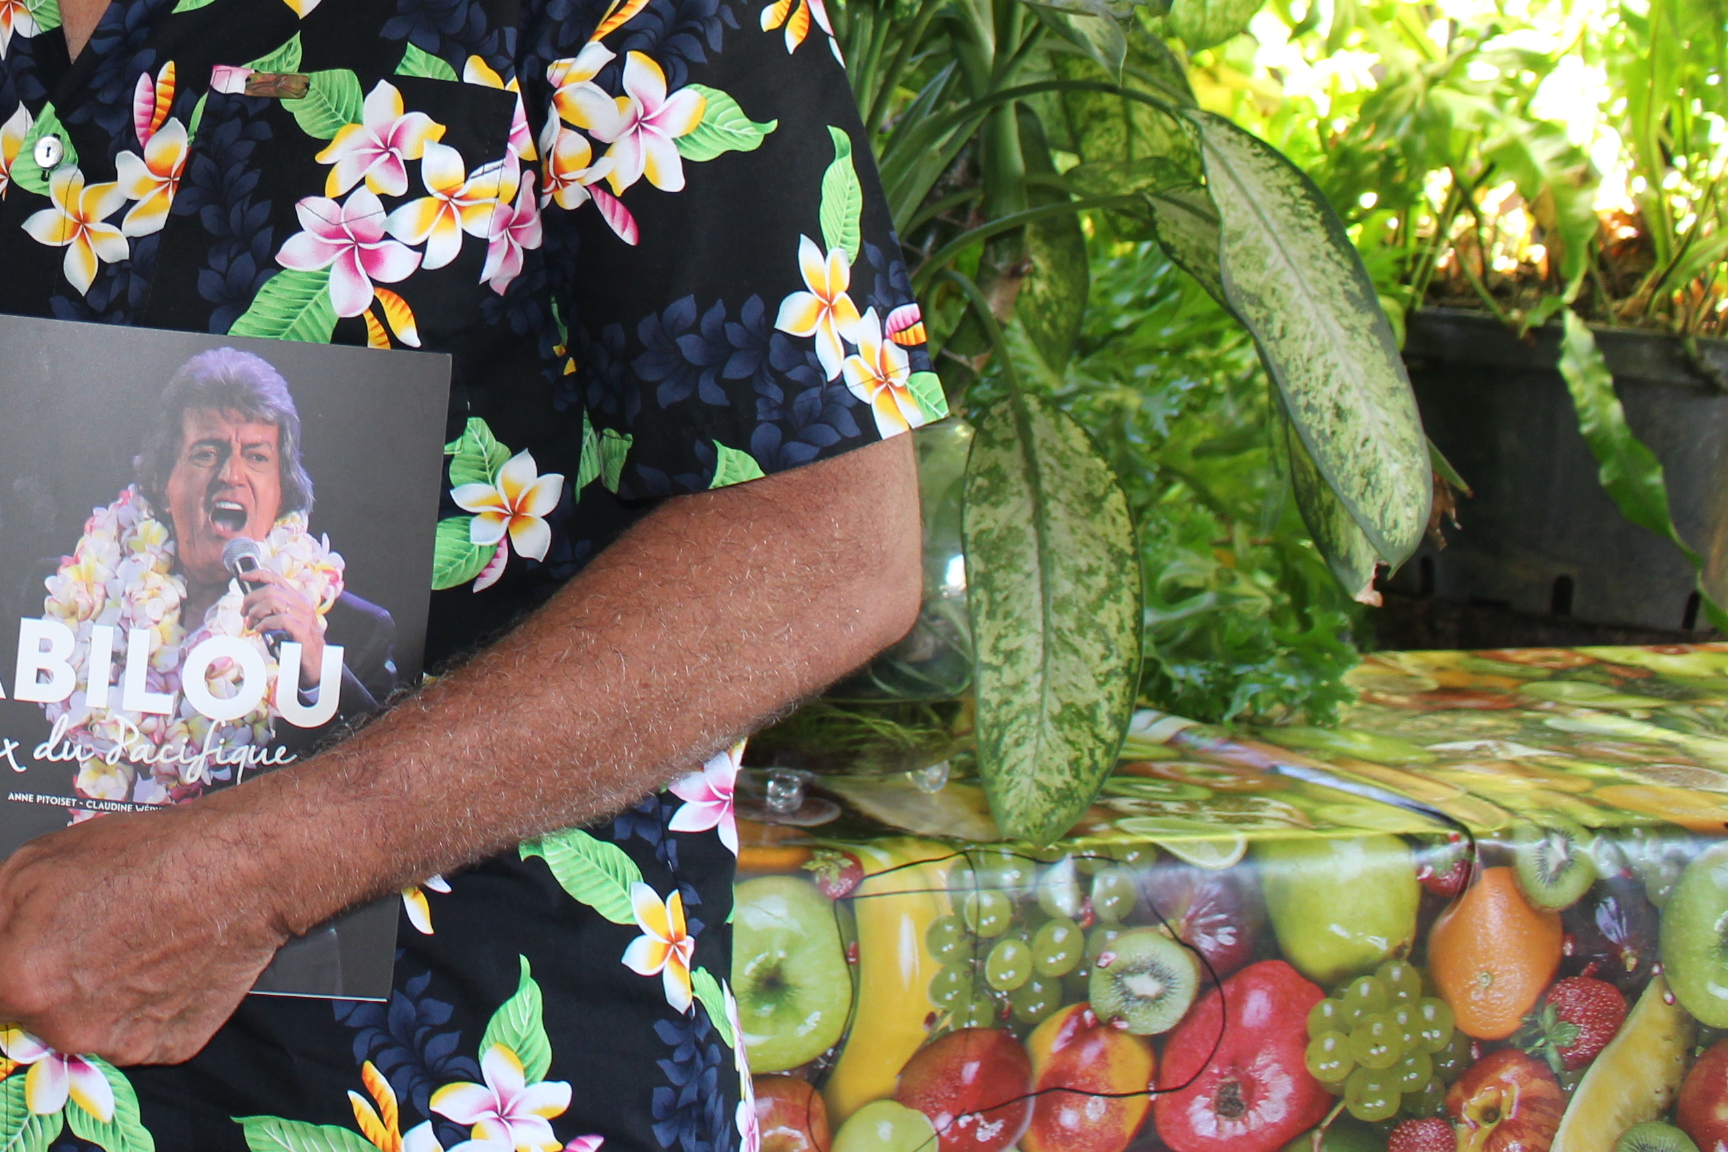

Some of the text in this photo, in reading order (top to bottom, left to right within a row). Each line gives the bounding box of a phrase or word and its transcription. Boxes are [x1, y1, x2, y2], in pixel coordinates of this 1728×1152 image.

[33, 713, 94, 764] du
[90, 715, 298, 785] Pacifique
[8, 792, 34, 803] ANNE
[36, 794, 78, 807] PITOISET
[85, 800, 132, 813] CLAUDINE
